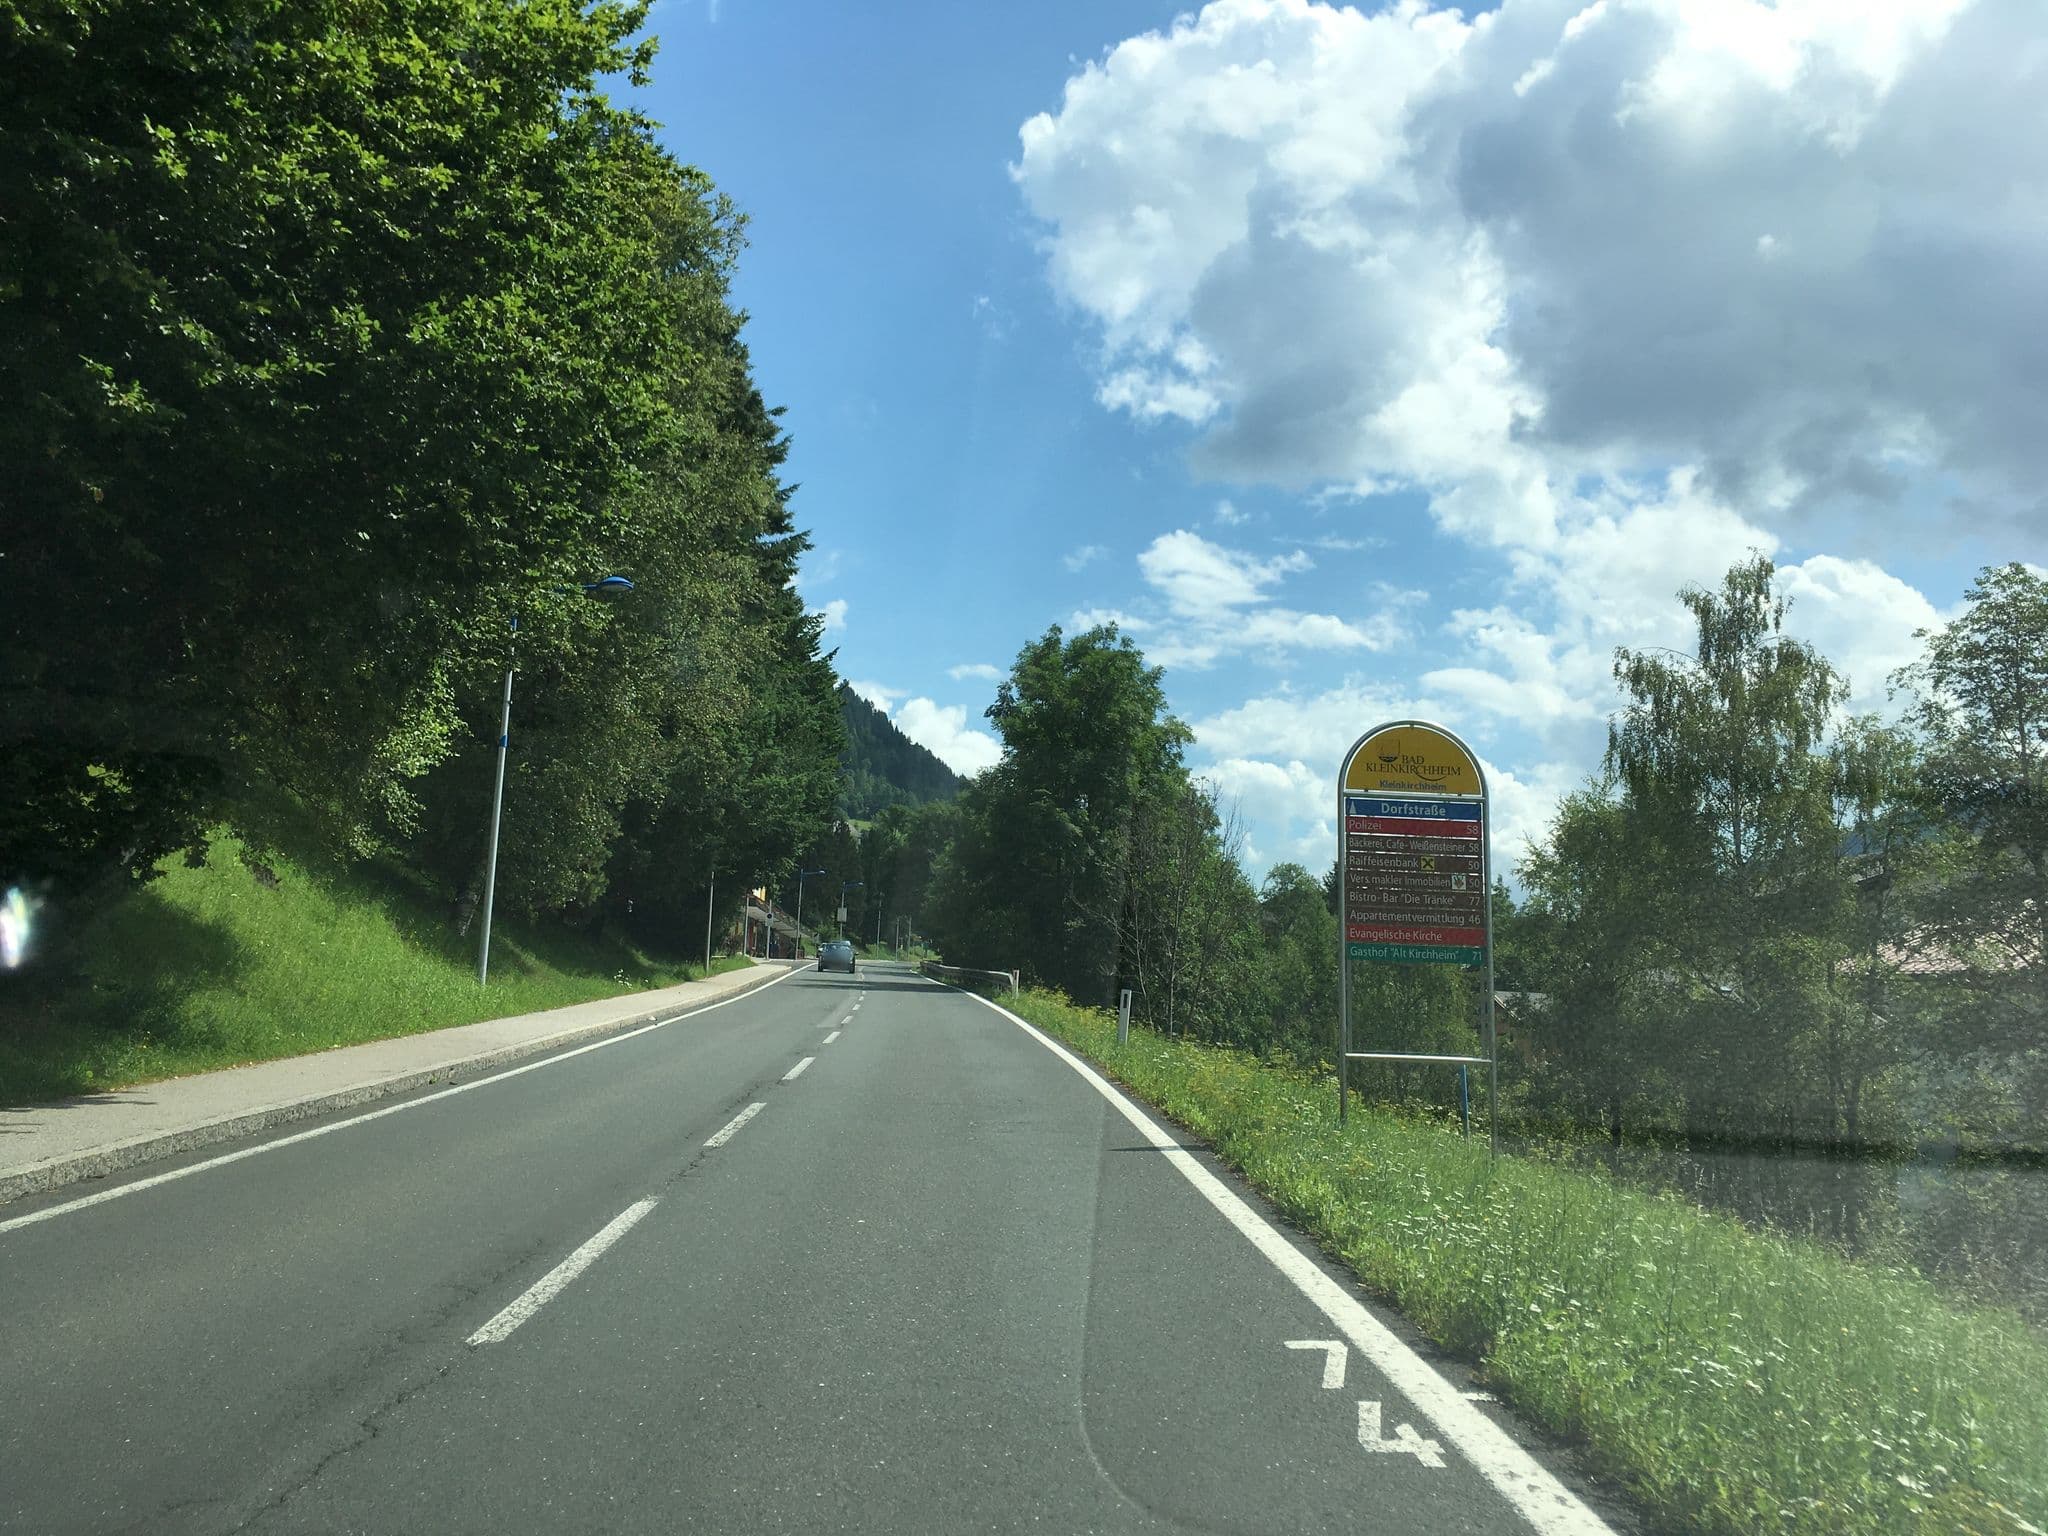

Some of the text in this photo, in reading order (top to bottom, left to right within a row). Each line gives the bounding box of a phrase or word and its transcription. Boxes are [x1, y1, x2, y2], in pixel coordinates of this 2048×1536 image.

[1401, 755, 1425, 765] BAD
[1366, 763, 1461, 776] KLEINKIRCHHEIM
[1380, 780, 1446, 790] Kleinkirchheim
[1381, 803, 1446, 816] Dorfstraße
[1349, 820, 1479, 834] Polizei 58
[1409, 839, 1465, 853] Weißensteiner
[1469, 843, 1479, 853] 58
[1349, 856, 1480, 870] Raiffeisenbank 50
[1404, 876, 1451, 887] Immobilien
[1469, 879, 1480, 888] 50
[1383, 893, 1398, 904] Bar
[1470, 897, 1480, 906] 77
[1350, 910, 1480, 926] Appartementvermittlung 46
[1350, 928, 1442, 941] Evangelische Kirche
[1350, 946, 1388, 958] Gasthof
[1472, 951, 1482, 961] 71
